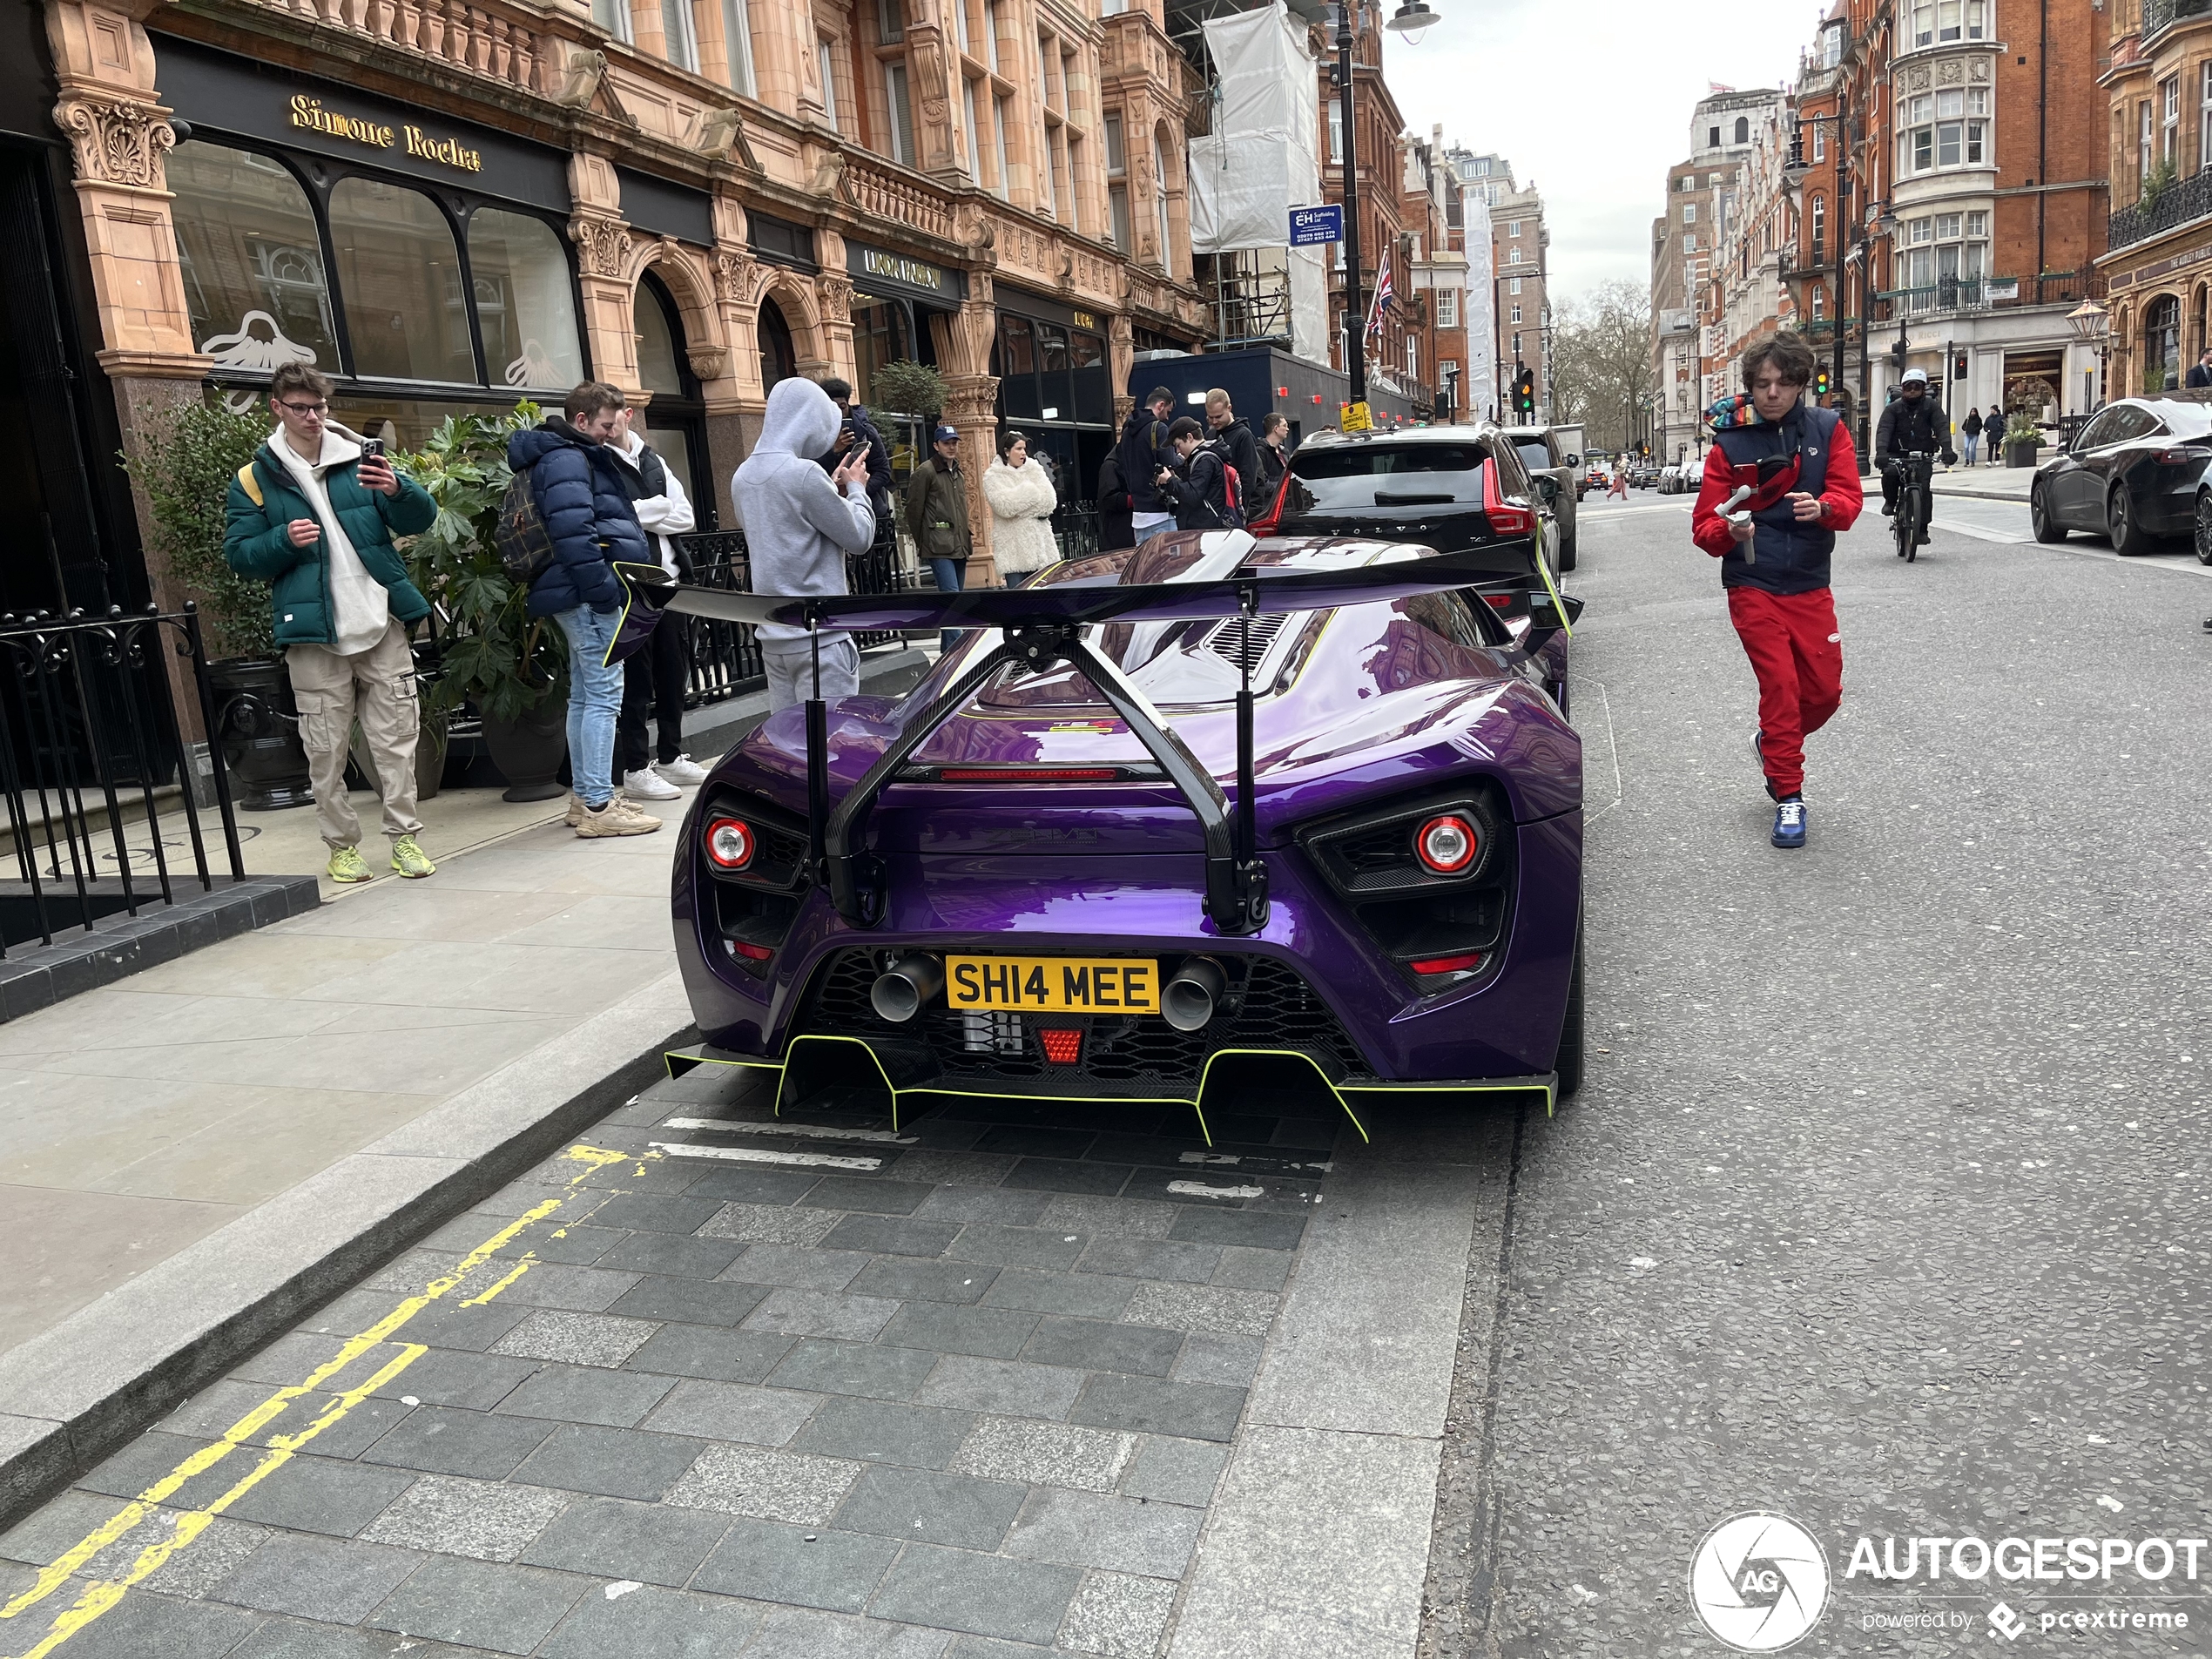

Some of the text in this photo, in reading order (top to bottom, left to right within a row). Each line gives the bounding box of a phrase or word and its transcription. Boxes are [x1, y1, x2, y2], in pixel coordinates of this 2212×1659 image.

[291, 94, 484, 172] Simone Rocha
[1331, 524, 1427, 536] VOLVO
[954, 963, 1150, 1007] SH14 MEE
